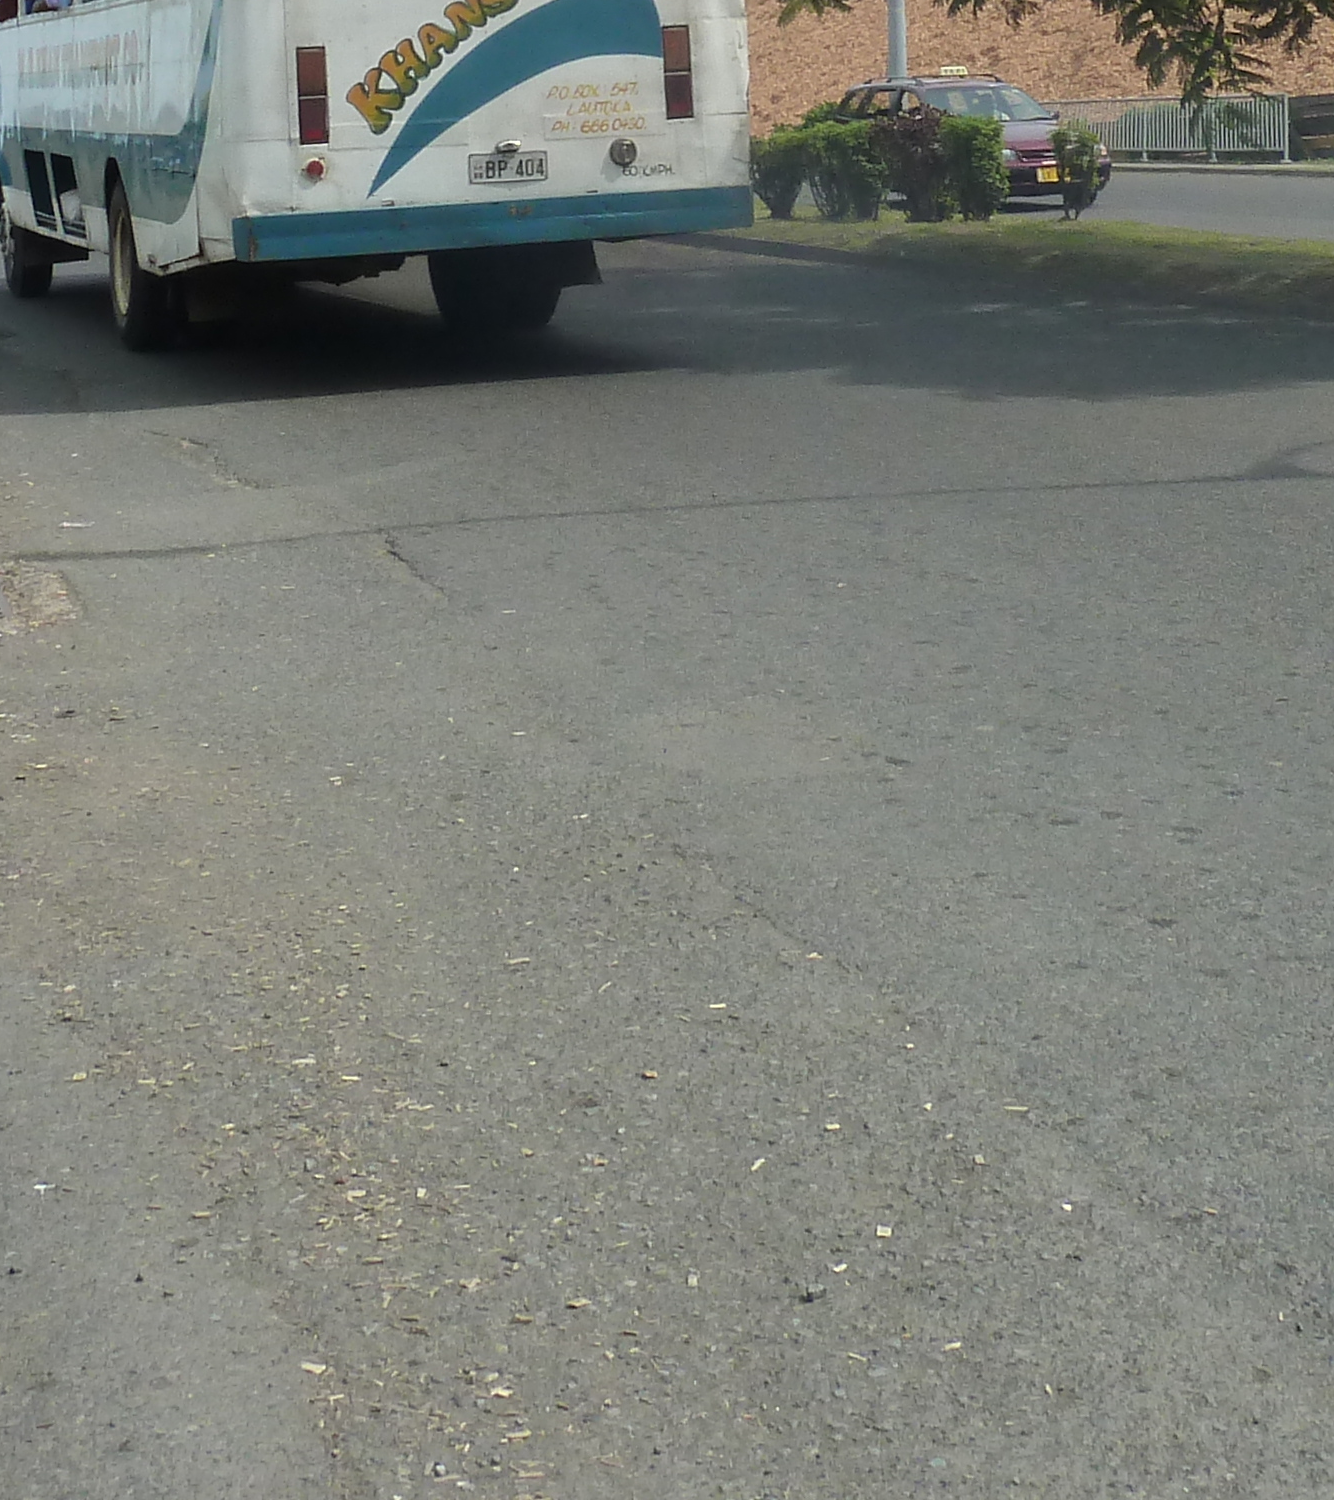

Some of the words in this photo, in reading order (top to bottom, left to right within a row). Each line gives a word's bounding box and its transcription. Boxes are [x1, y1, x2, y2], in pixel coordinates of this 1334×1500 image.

[573, 84, 600, 98] BOX
[580, 119, 609, 133] 666
[485, 160, 507, 179] BP
[515, 158, 545, 177] 404
